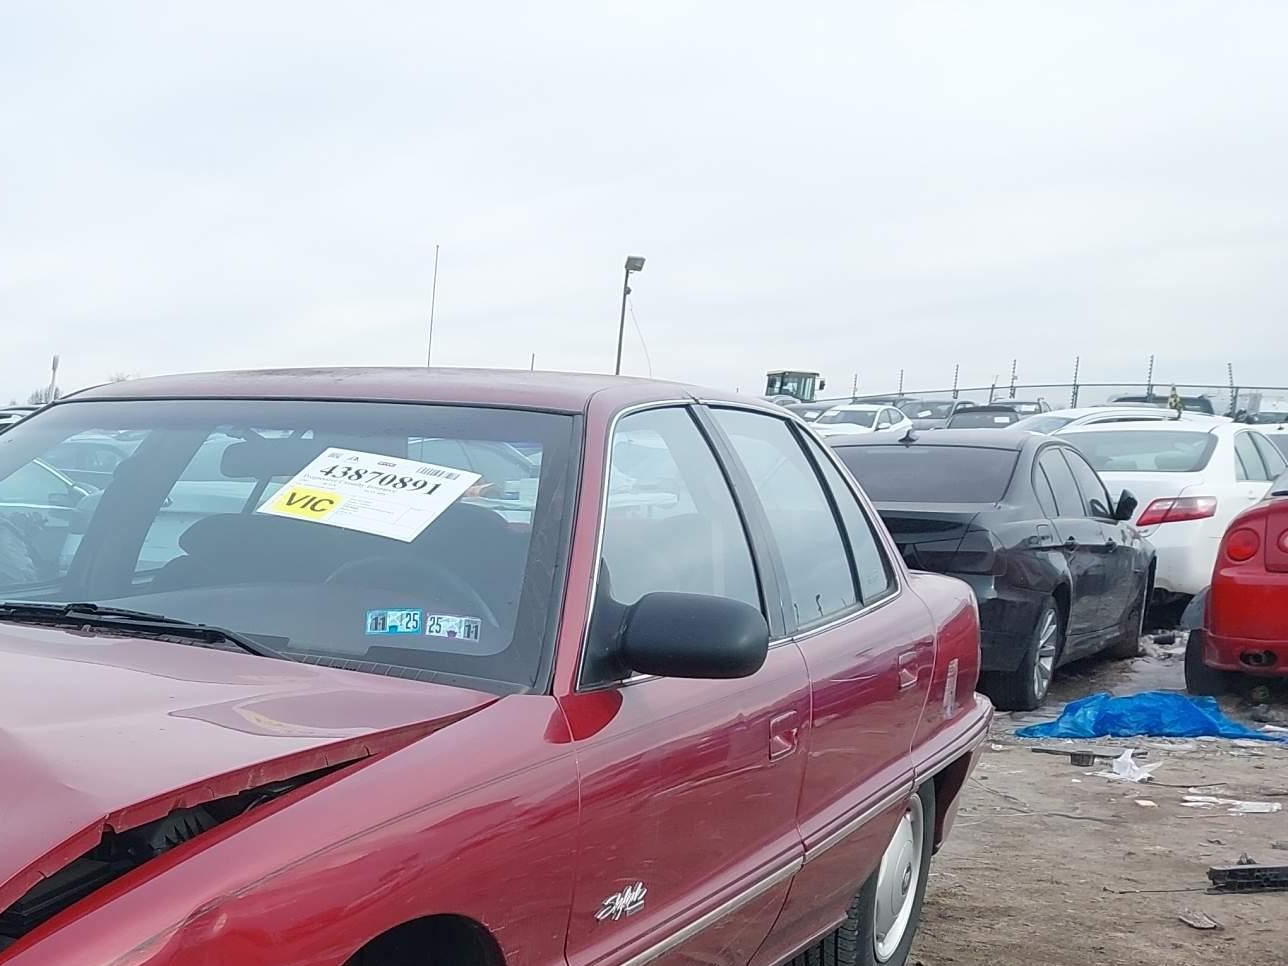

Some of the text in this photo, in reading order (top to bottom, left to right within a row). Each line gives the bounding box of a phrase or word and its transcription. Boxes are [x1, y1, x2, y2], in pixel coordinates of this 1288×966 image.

[319, 464, 443, 496] 43870891
[285, 492, 335, 514] VIC
[405, 612, 419, 630] 25
[428, 616, 442, 634] 25
